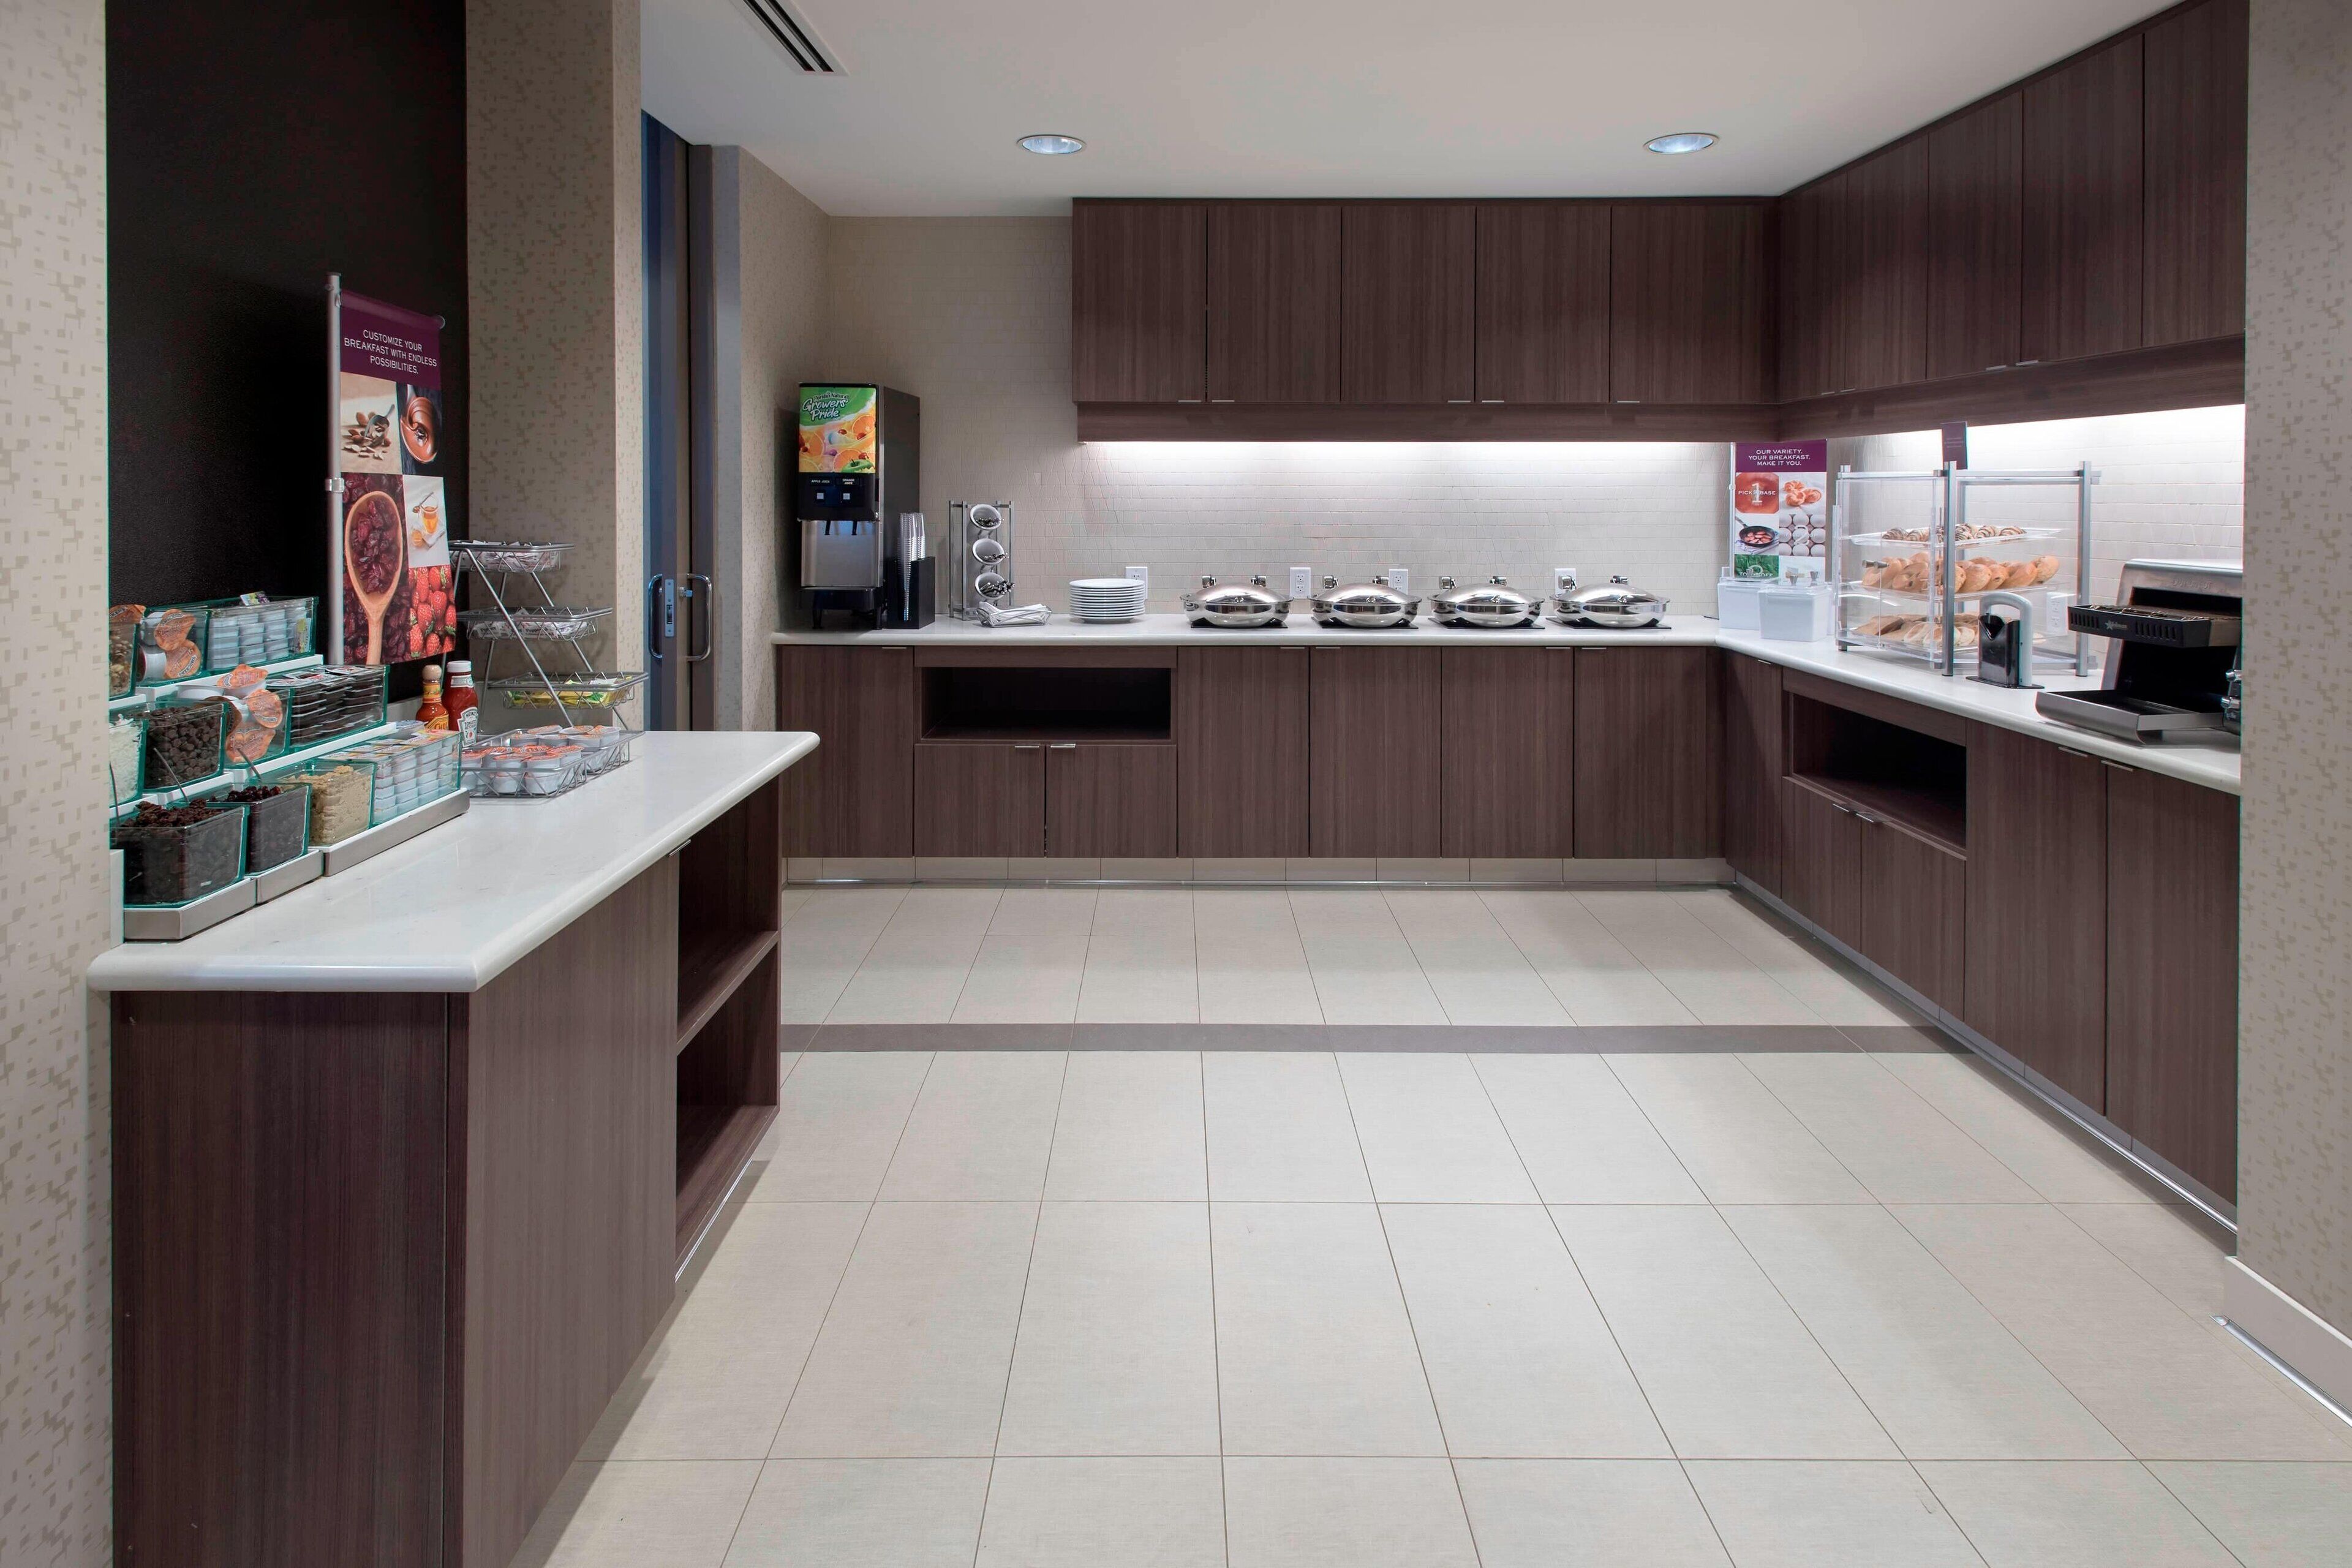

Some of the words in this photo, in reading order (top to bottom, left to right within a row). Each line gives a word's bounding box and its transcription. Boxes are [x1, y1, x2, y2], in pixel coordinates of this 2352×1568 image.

[363, 330, 403, 347] CUSTOMIZE
[405, 341, 423, 352] YOUR
[344, 337, 389, 355] BREAKFAST
[390, 348, 407, 360] WITH
[409, 353, 437, 367] ENDLESS
[370, 355, 419, 374] POSSIBILITIES.
[810, 407, 839, 421] Pride
[1752, 483, 1763, 503] 1
